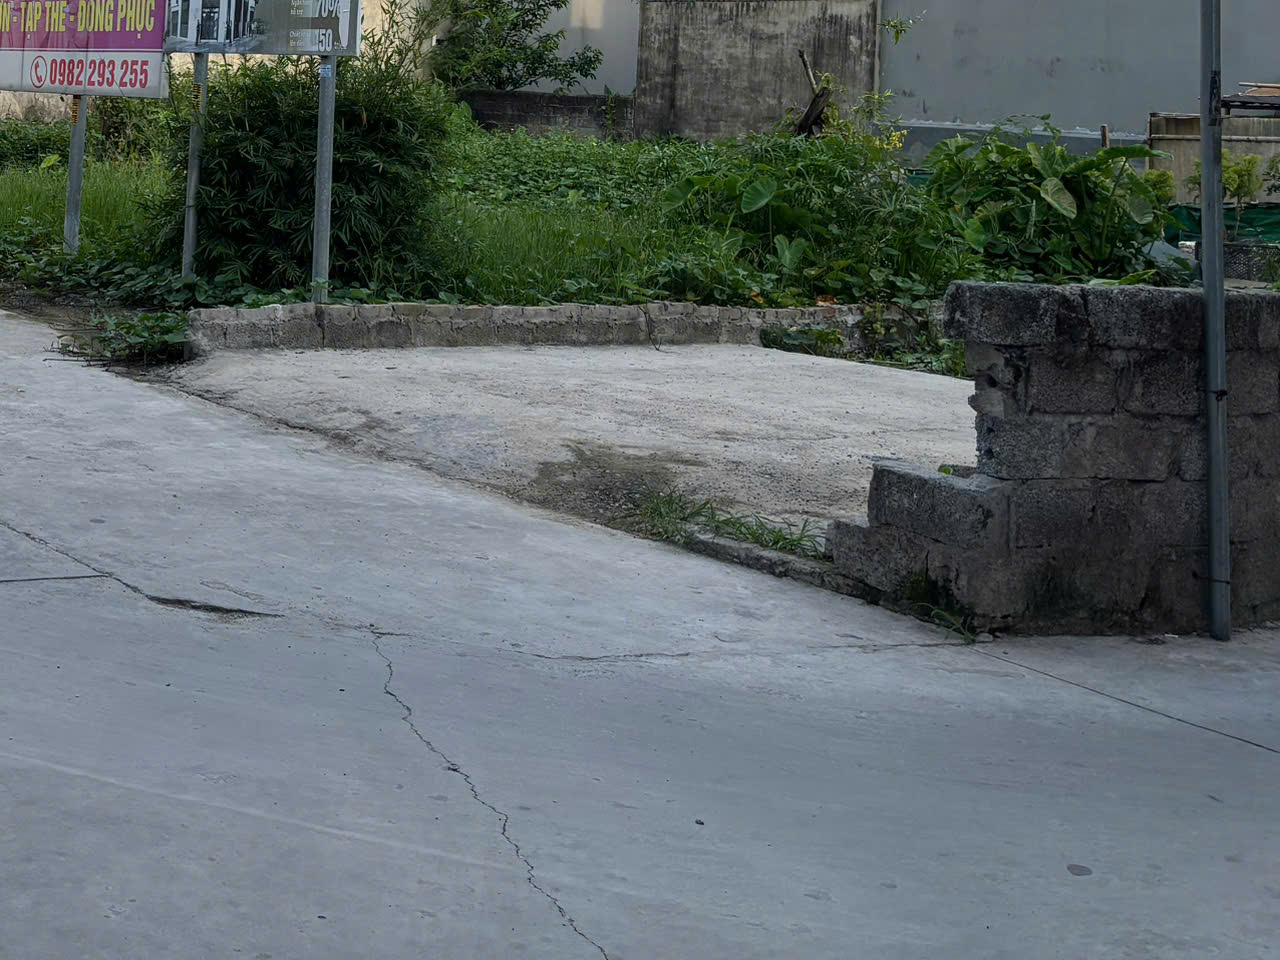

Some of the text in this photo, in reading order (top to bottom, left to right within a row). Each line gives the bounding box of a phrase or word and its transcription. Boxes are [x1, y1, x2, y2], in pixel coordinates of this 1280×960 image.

[50, 58, 149, 88] 0982 293 255
